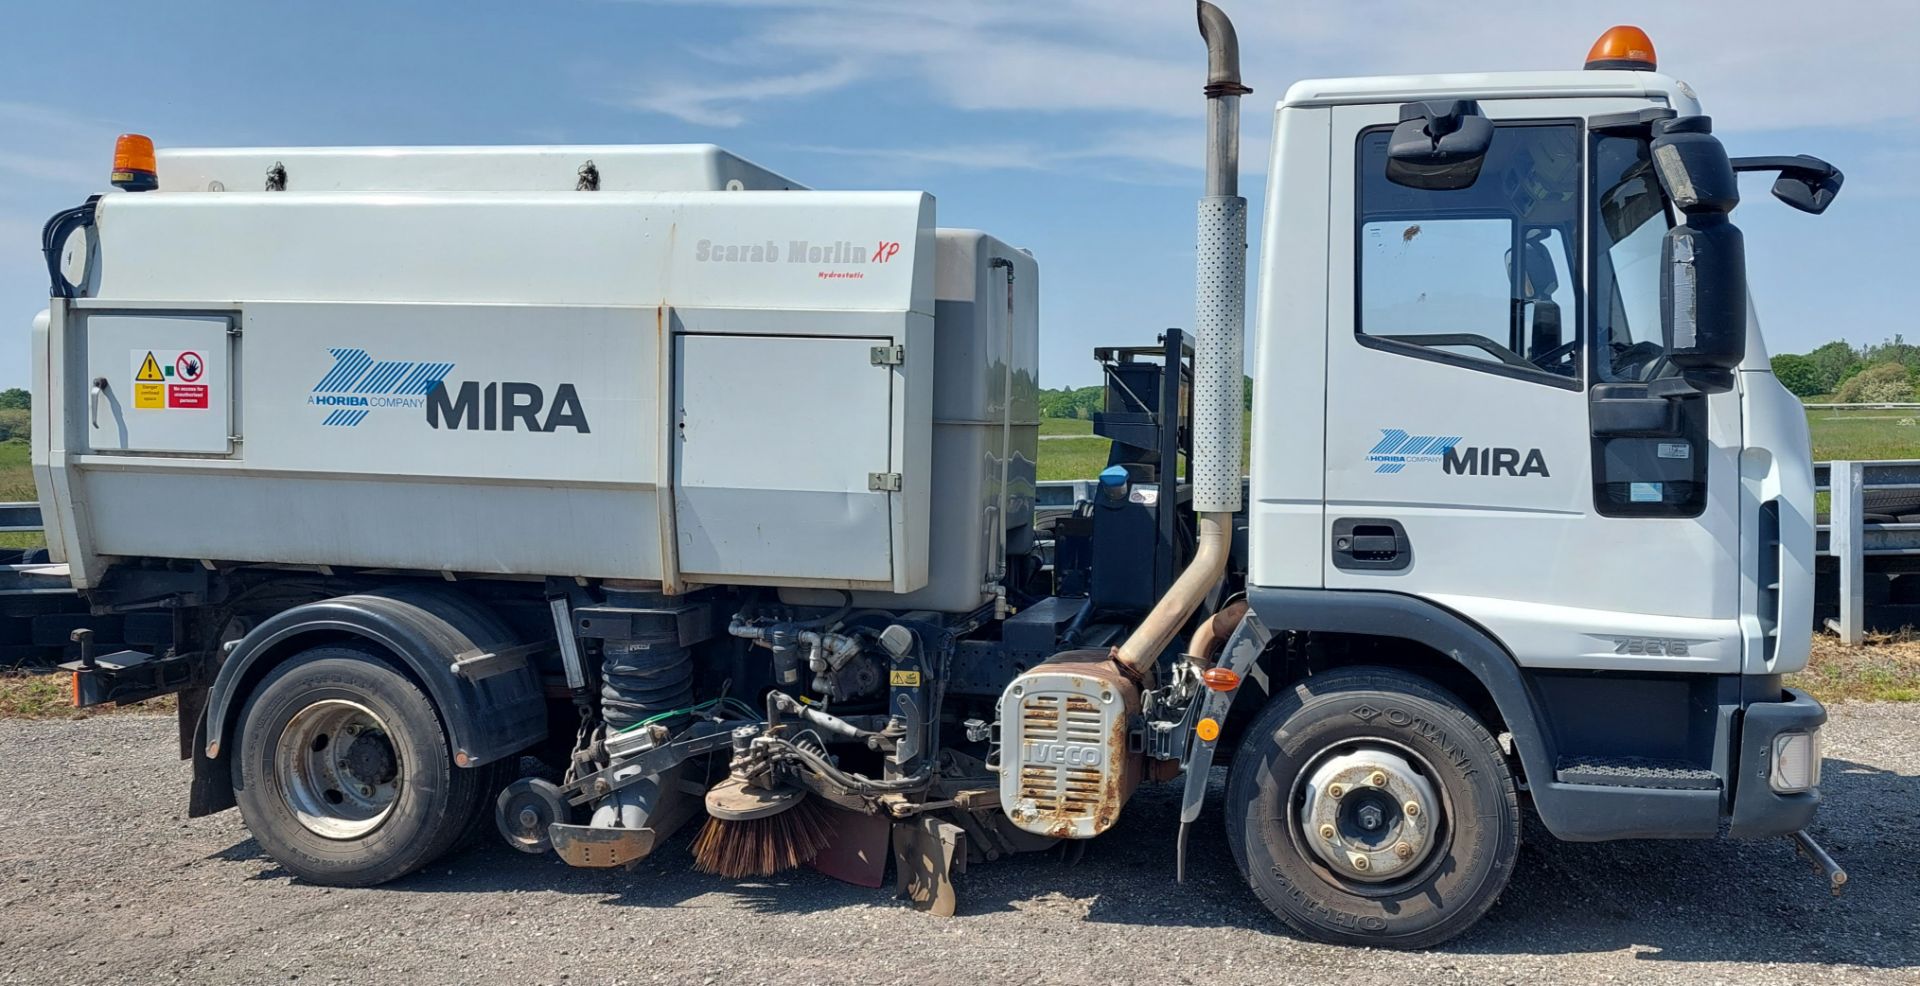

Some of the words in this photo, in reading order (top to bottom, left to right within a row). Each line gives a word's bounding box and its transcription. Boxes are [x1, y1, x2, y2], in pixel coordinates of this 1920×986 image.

[695, 239, 779, 263] Scarab
[787, 240, 866, 264] Merlin
[872, 241, 900, 263] XP
[818, 271, 864, 279] Hydrostatic
[307, 396, 315, 405] A
[316, 396, 369, 407] HORIBA
[370, 397, 425, 409] COMPANY
[426, 381, 591, 433] MIRA
[1442, 447, 1550, 477] MIRA
[1023, 743, 1102, 767] IVECO
[1381, 706, 1478, 781] OTANI
